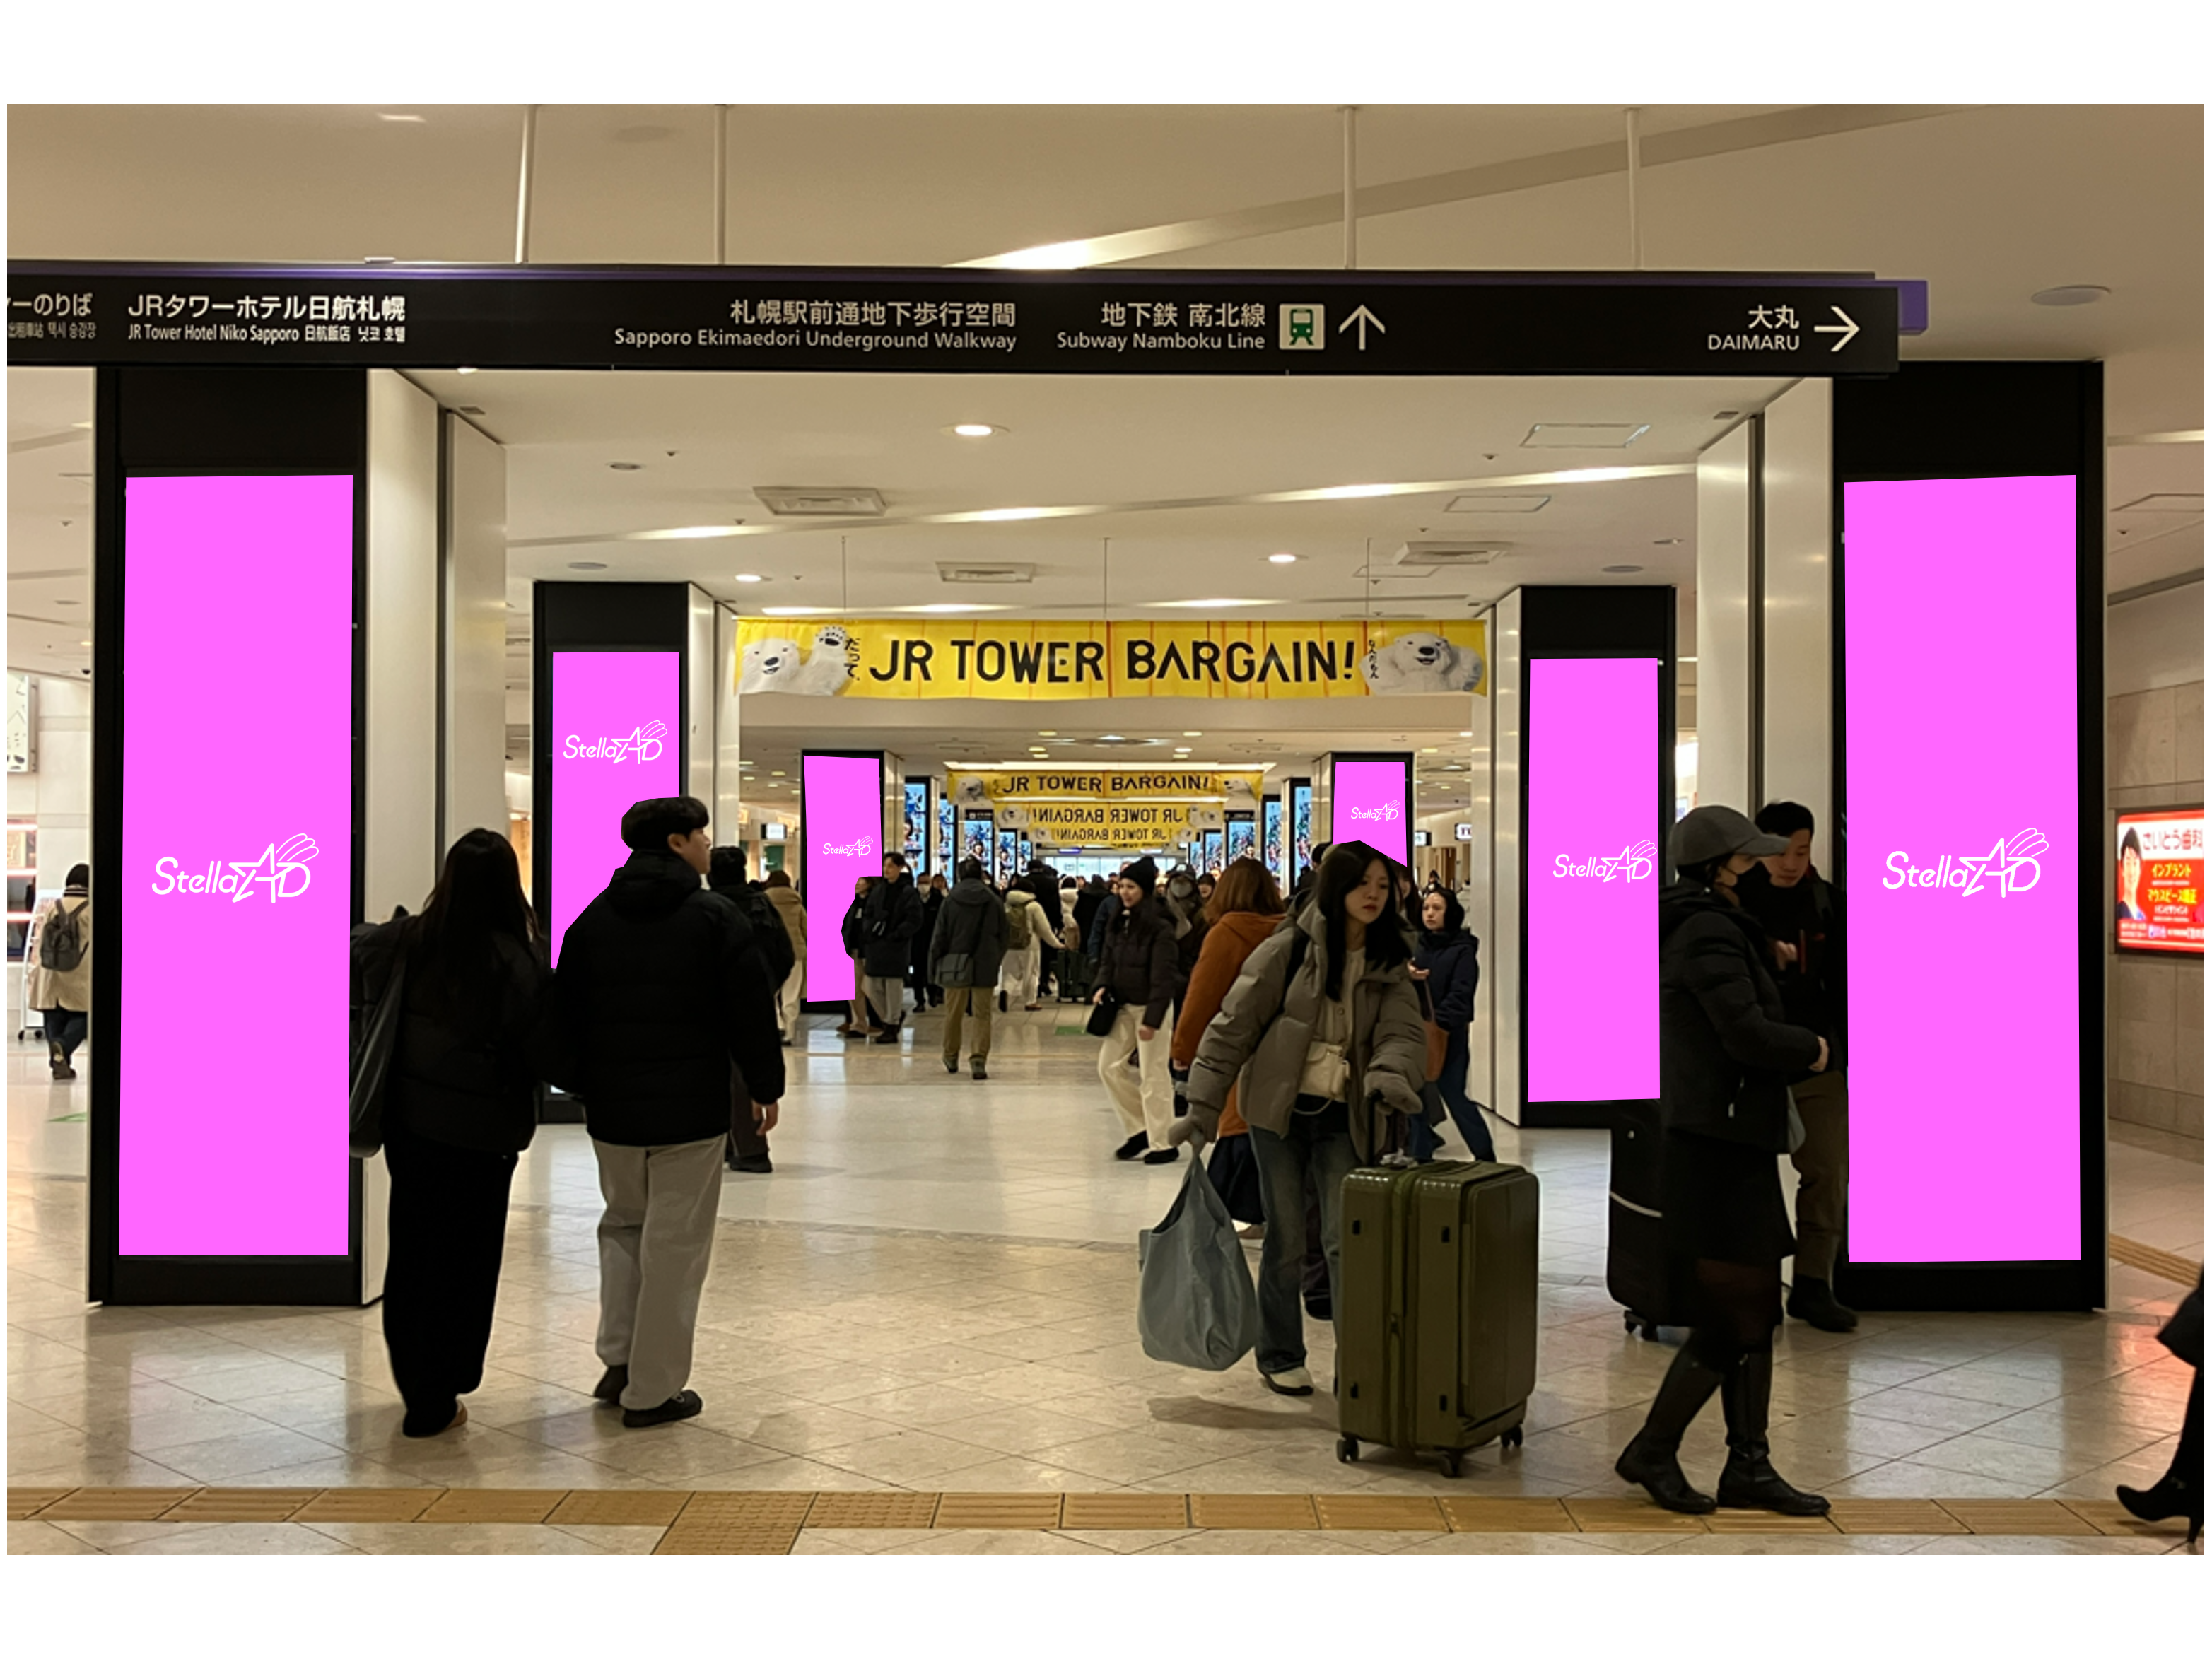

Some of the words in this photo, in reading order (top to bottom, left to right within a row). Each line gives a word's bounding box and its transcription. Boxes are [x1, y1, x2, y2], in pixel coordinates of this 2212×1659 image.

[7, 293, 92, 316] ーのりば
[129, 295, 405, 321] JRタワーホテル日航札幌
[731, 300, 1014, 327] 札幌駅前通地下歩行空間
[1101, 303, 1177, 327] 地下鉄
[1189, 303, 1265, 327] 南北線
[1749, 305, 1799, 329] 大丸
[129, 324, 141, 339] JR
[144, 324, 181, 339] Tower
[185, 324, 216, 340] Hotel
[221, 324, 247, 340] Niko
[250, 325, 299, 344] Sapporo
[616, 329, 691, 347] Sapporo
[699, 329, 799, 346] Ekimaedori
[807, 332, 927, 351] Underground
[935, 332, 1016, 351] Walkway
[1058, 332, 1127, 351] Subway
[1134, 333, 1221, 348] Namboku
[1229, 333, 1265, 348] Line
[1709, 335, 1799, 350] DAIMARU
[870, 640, 932, 681] JR
[951, 640, 1104, 683] TOWER
[1128, 640, 1354, 682] BARGAIN!
[1002, 777, 1029, 793] JR
[1037, 776, 1101, 792] TOWER
[1112, 773, 1207, 790] BARGAIN!
